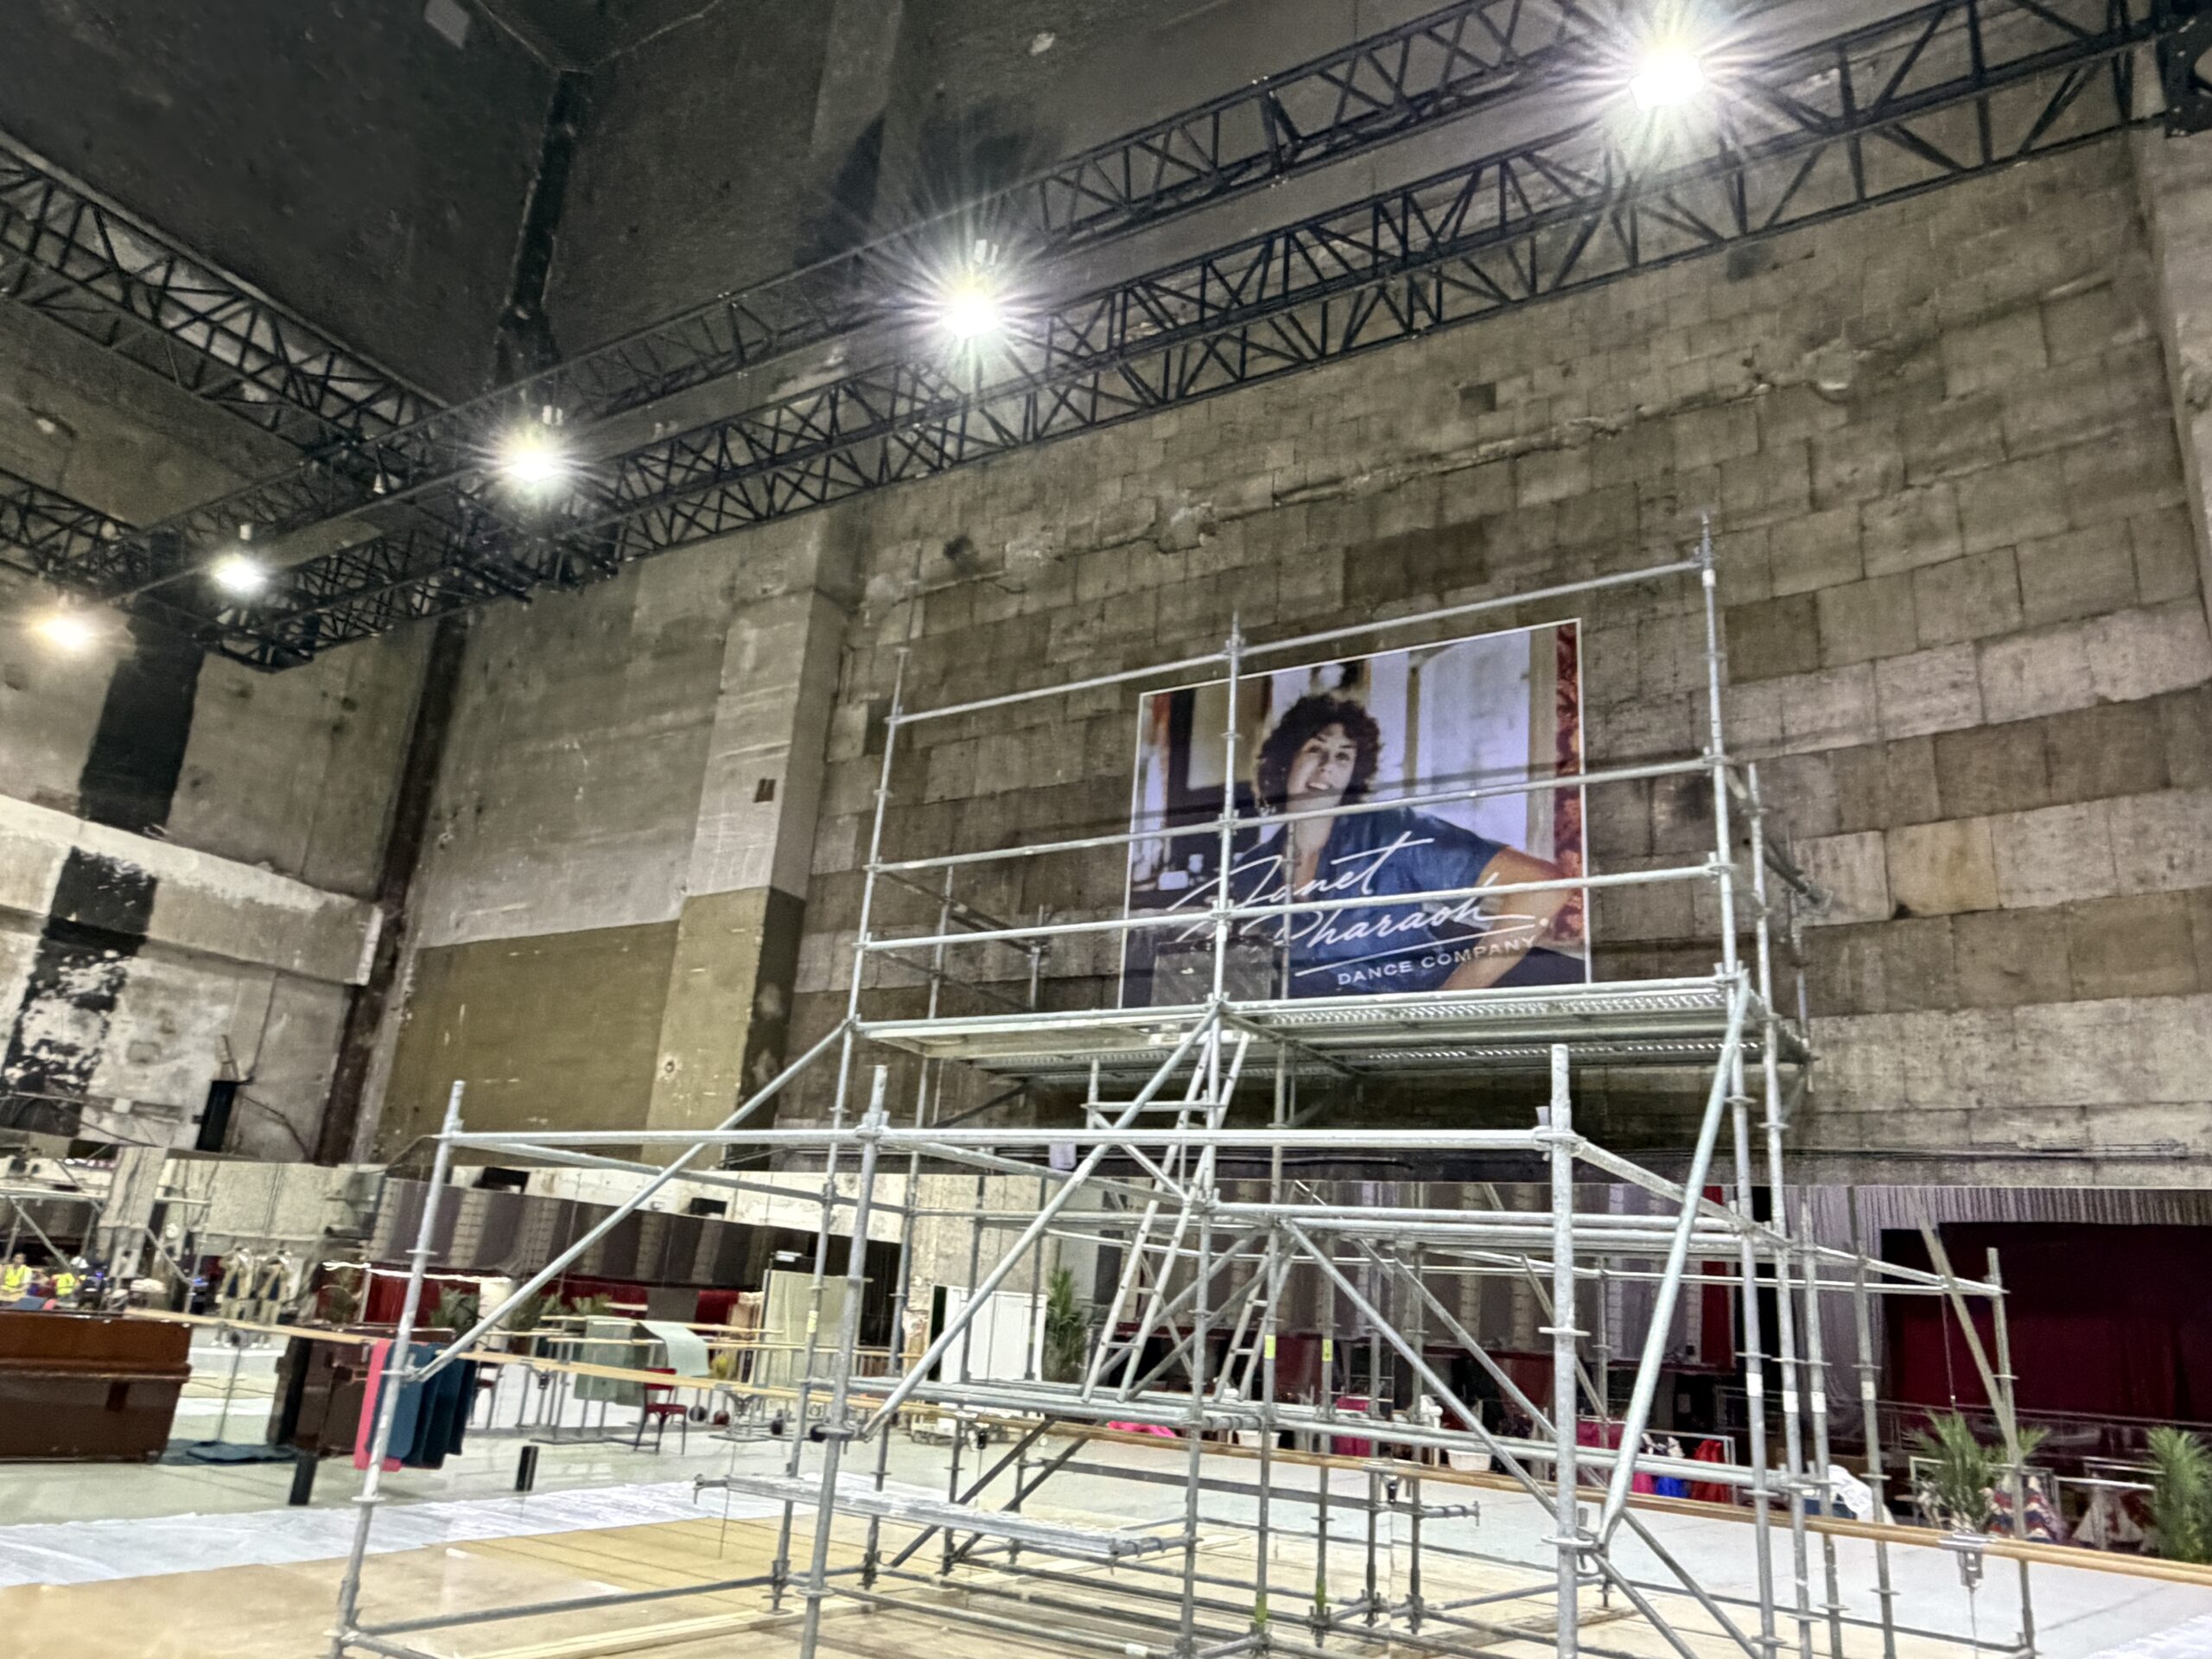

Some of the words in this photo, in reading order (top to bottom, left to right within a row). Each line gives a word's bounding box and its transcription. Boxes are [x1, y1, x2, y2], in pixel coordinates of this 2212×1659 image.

[1166, 830, 1434, 944] Janet
[1337, 960, 1413, 986] DANCE
[1421, 934, 1536, 969] COMPANY
